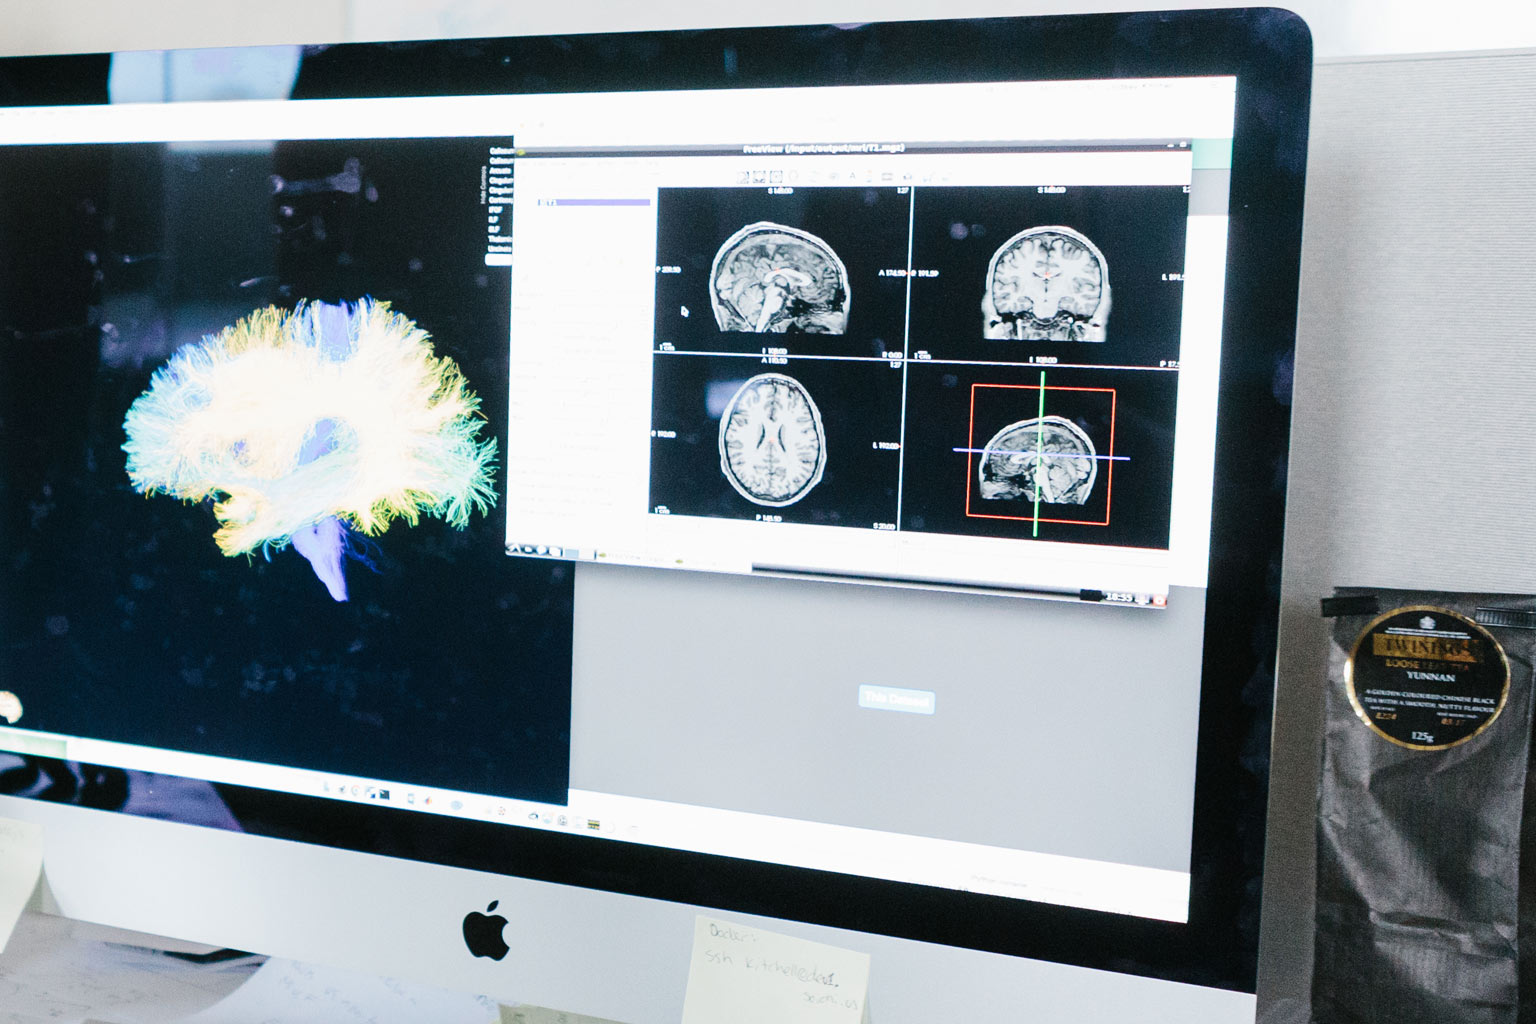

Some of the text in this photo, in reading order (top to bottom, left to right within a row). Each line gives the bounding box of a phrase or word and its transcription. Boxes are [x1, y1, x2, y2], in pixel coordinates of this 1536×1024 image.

[743, 145, 783, 153] FreeView
[1106, 592, 1133, 601] 18:55
[1385, 659, 1421, 669] LOOSE
[1406, 671, 1456, 682] YUNNAN
[1472, 697, 1496, 705] BLACK
[1411, 731, 1434, 743] 125g
